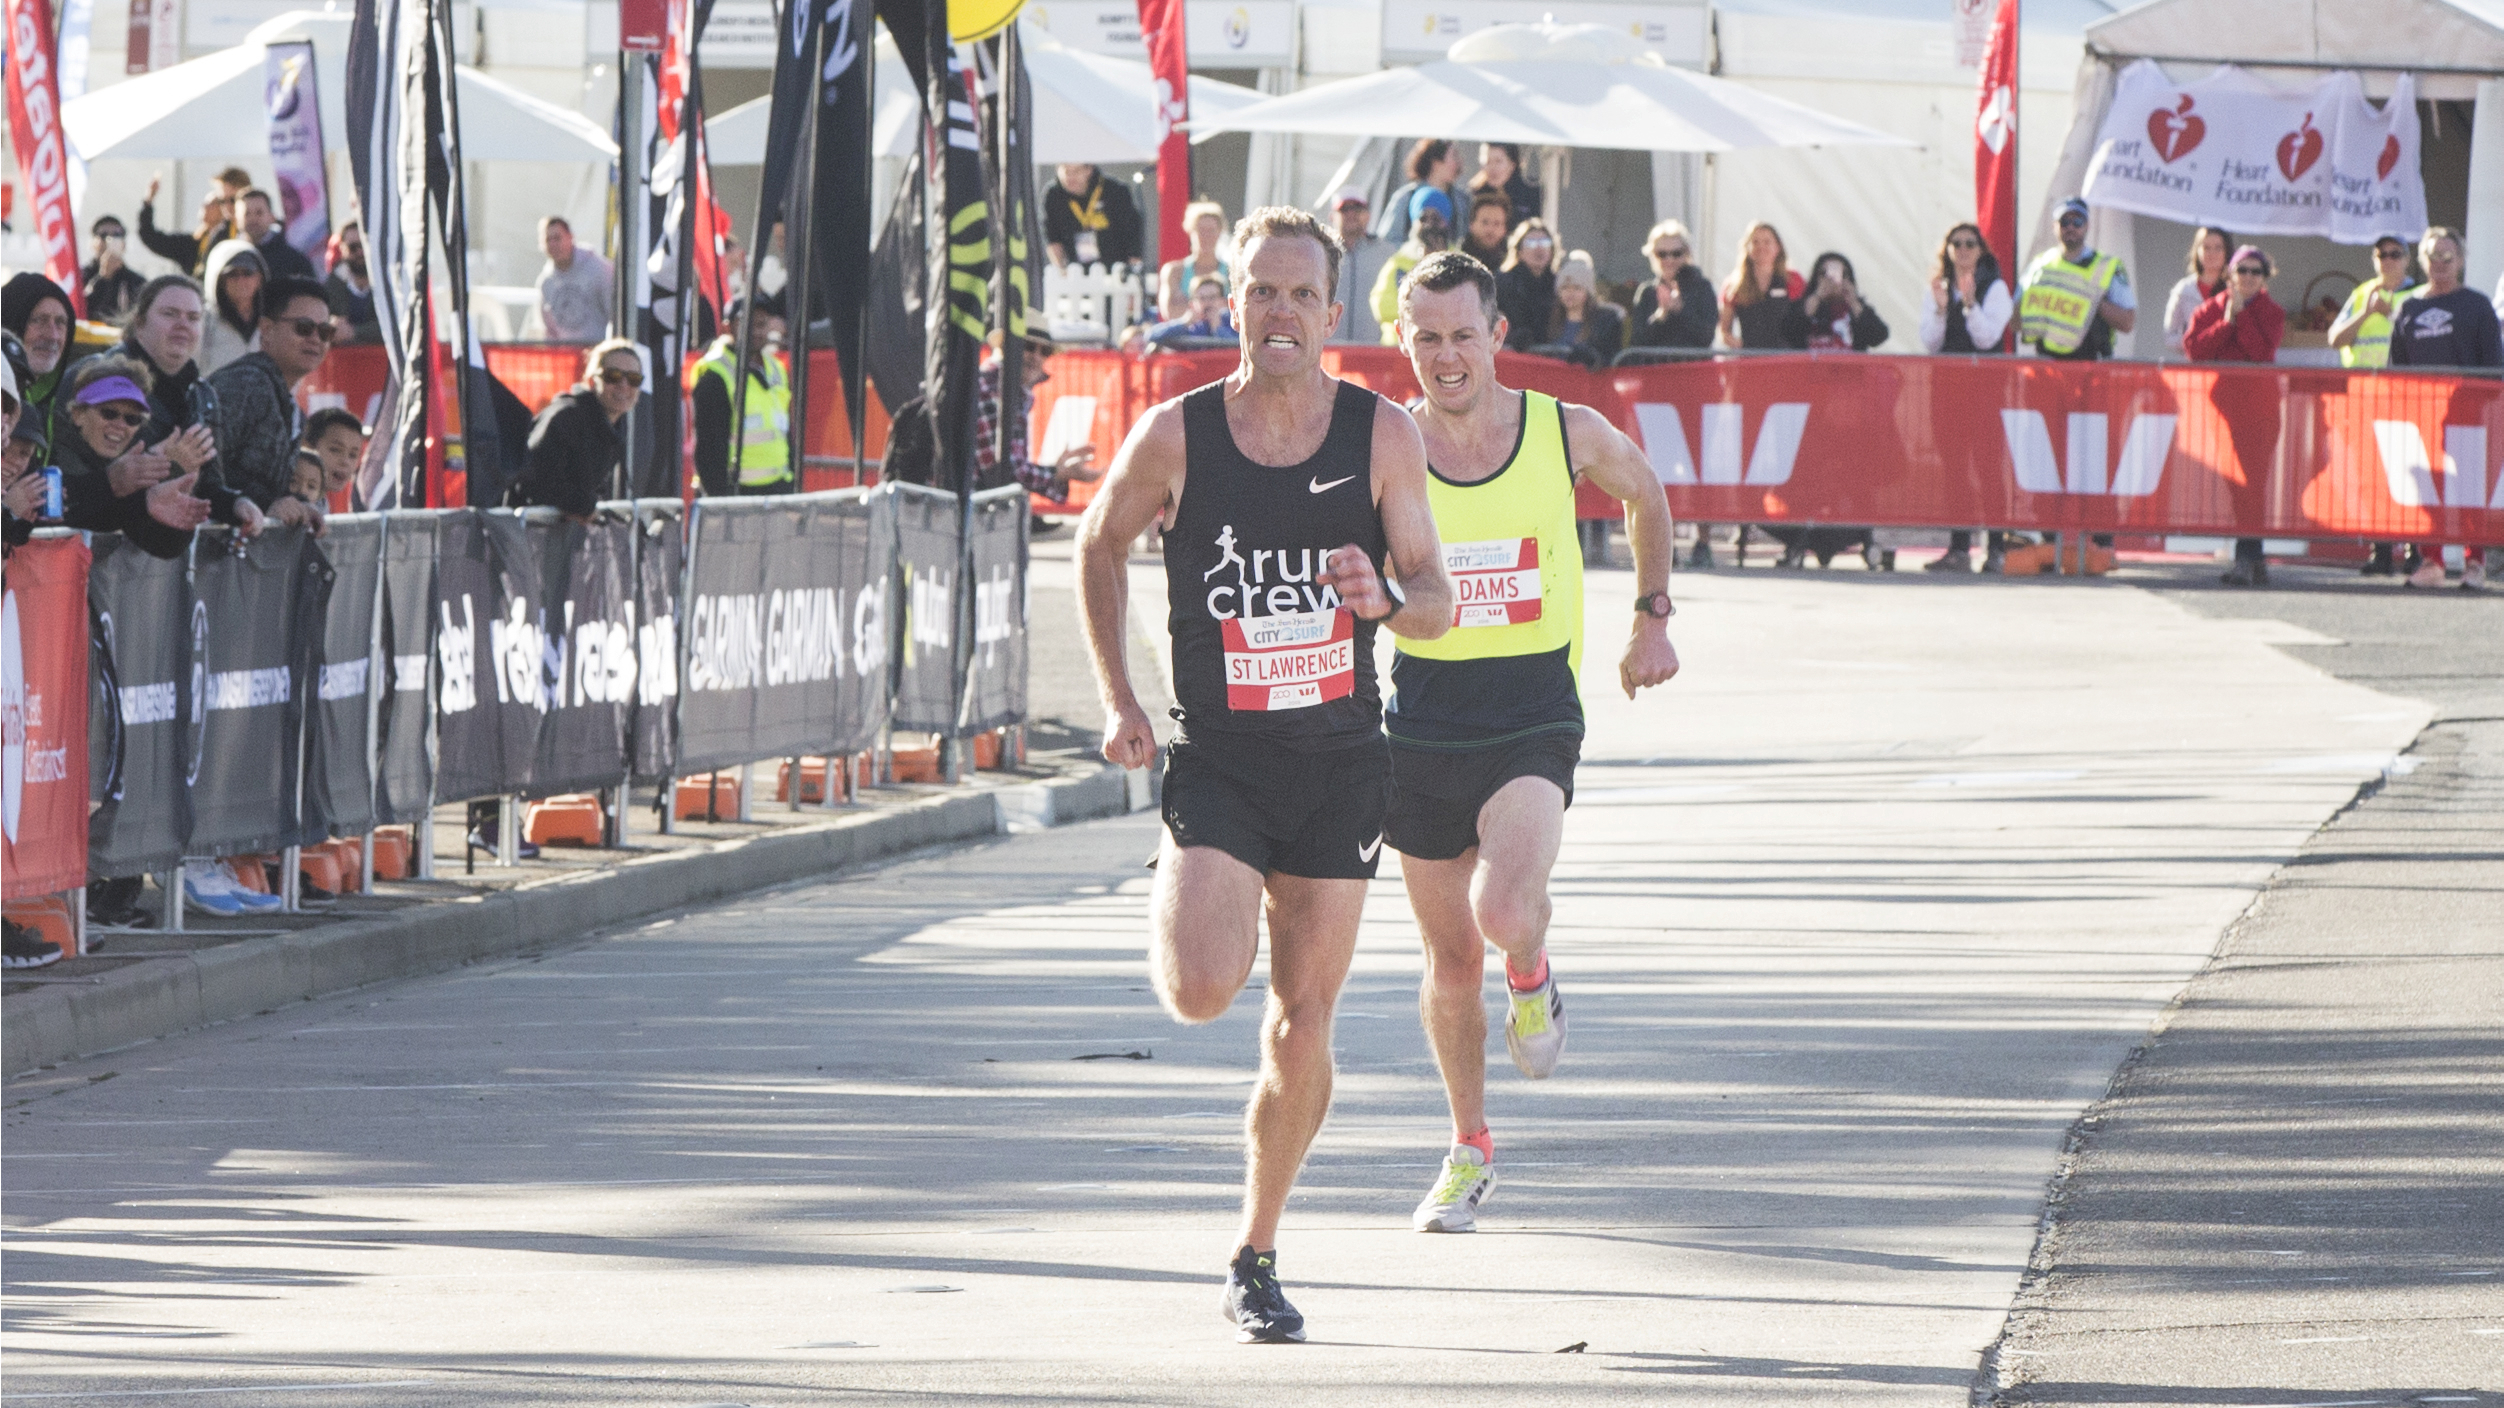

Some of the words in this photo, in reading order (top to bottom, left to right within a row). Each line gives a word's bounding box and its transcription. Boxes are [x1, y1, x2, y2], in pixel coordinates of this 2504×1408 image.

[2221, 157, 2270, 181] Heart
[2215, 180, 2322, 207] Foundation
[2026, 292, 2085, 321] POLICE
[1455, 576, 1519, 601] DAMS
[689, 593, 766, 692] GARMIN
[767, 587, 846, 687] GARMIN
[1232, 658, 1252, 680] ST
[1257, 646, 1347, 681] LAWRENCE
